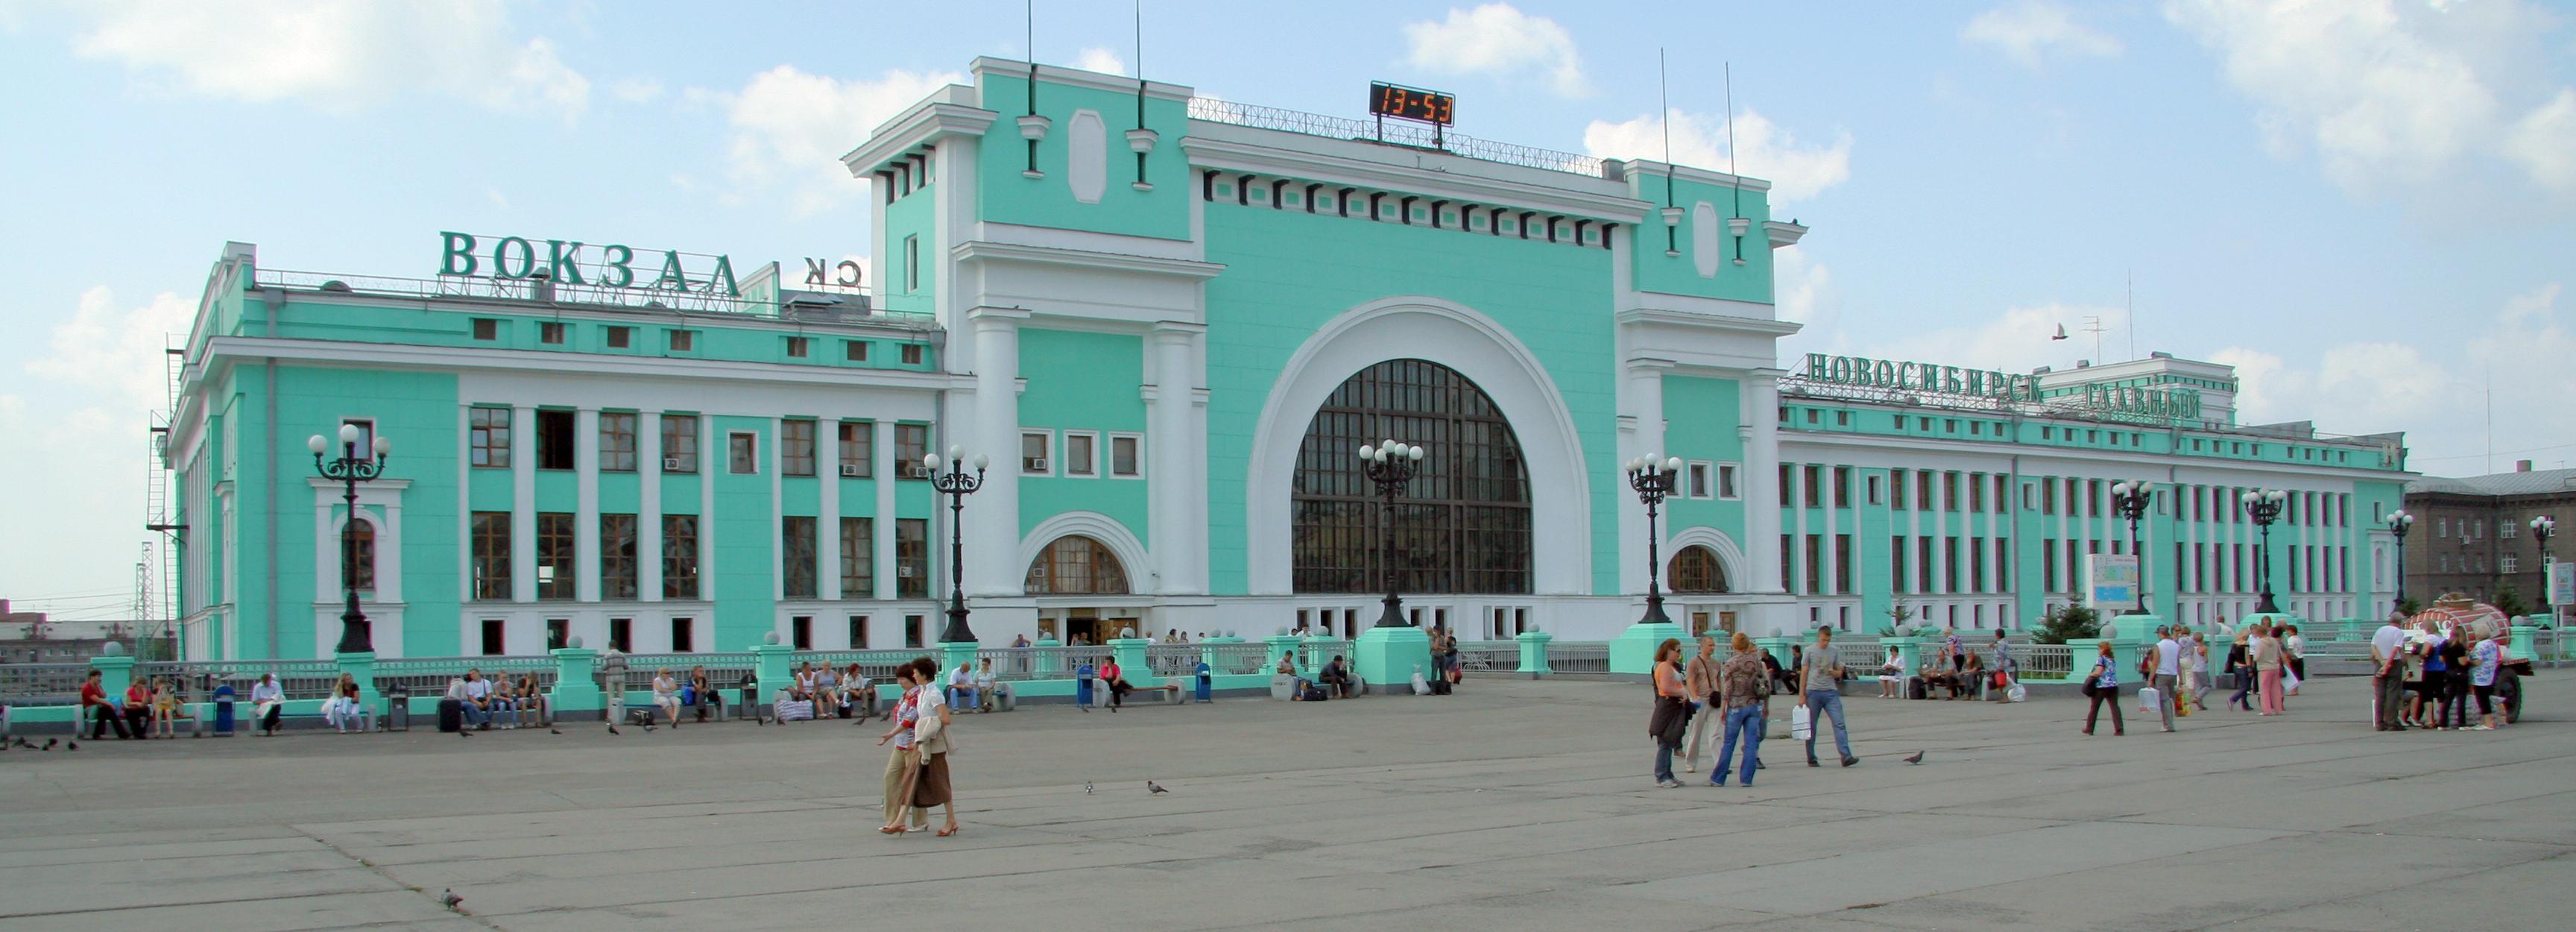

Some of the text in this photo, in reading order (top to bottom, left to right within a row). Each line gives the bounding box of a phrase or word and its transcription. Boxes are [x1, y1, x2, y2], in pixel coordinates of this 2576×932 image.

[1383, 87, 1452, 122] 13-53
[438, 230, 742, 297] ВОКЗАЛ
[1806, 353, 2200, 418] НОВОСИБИРСК ГЛАВНЫЙ
